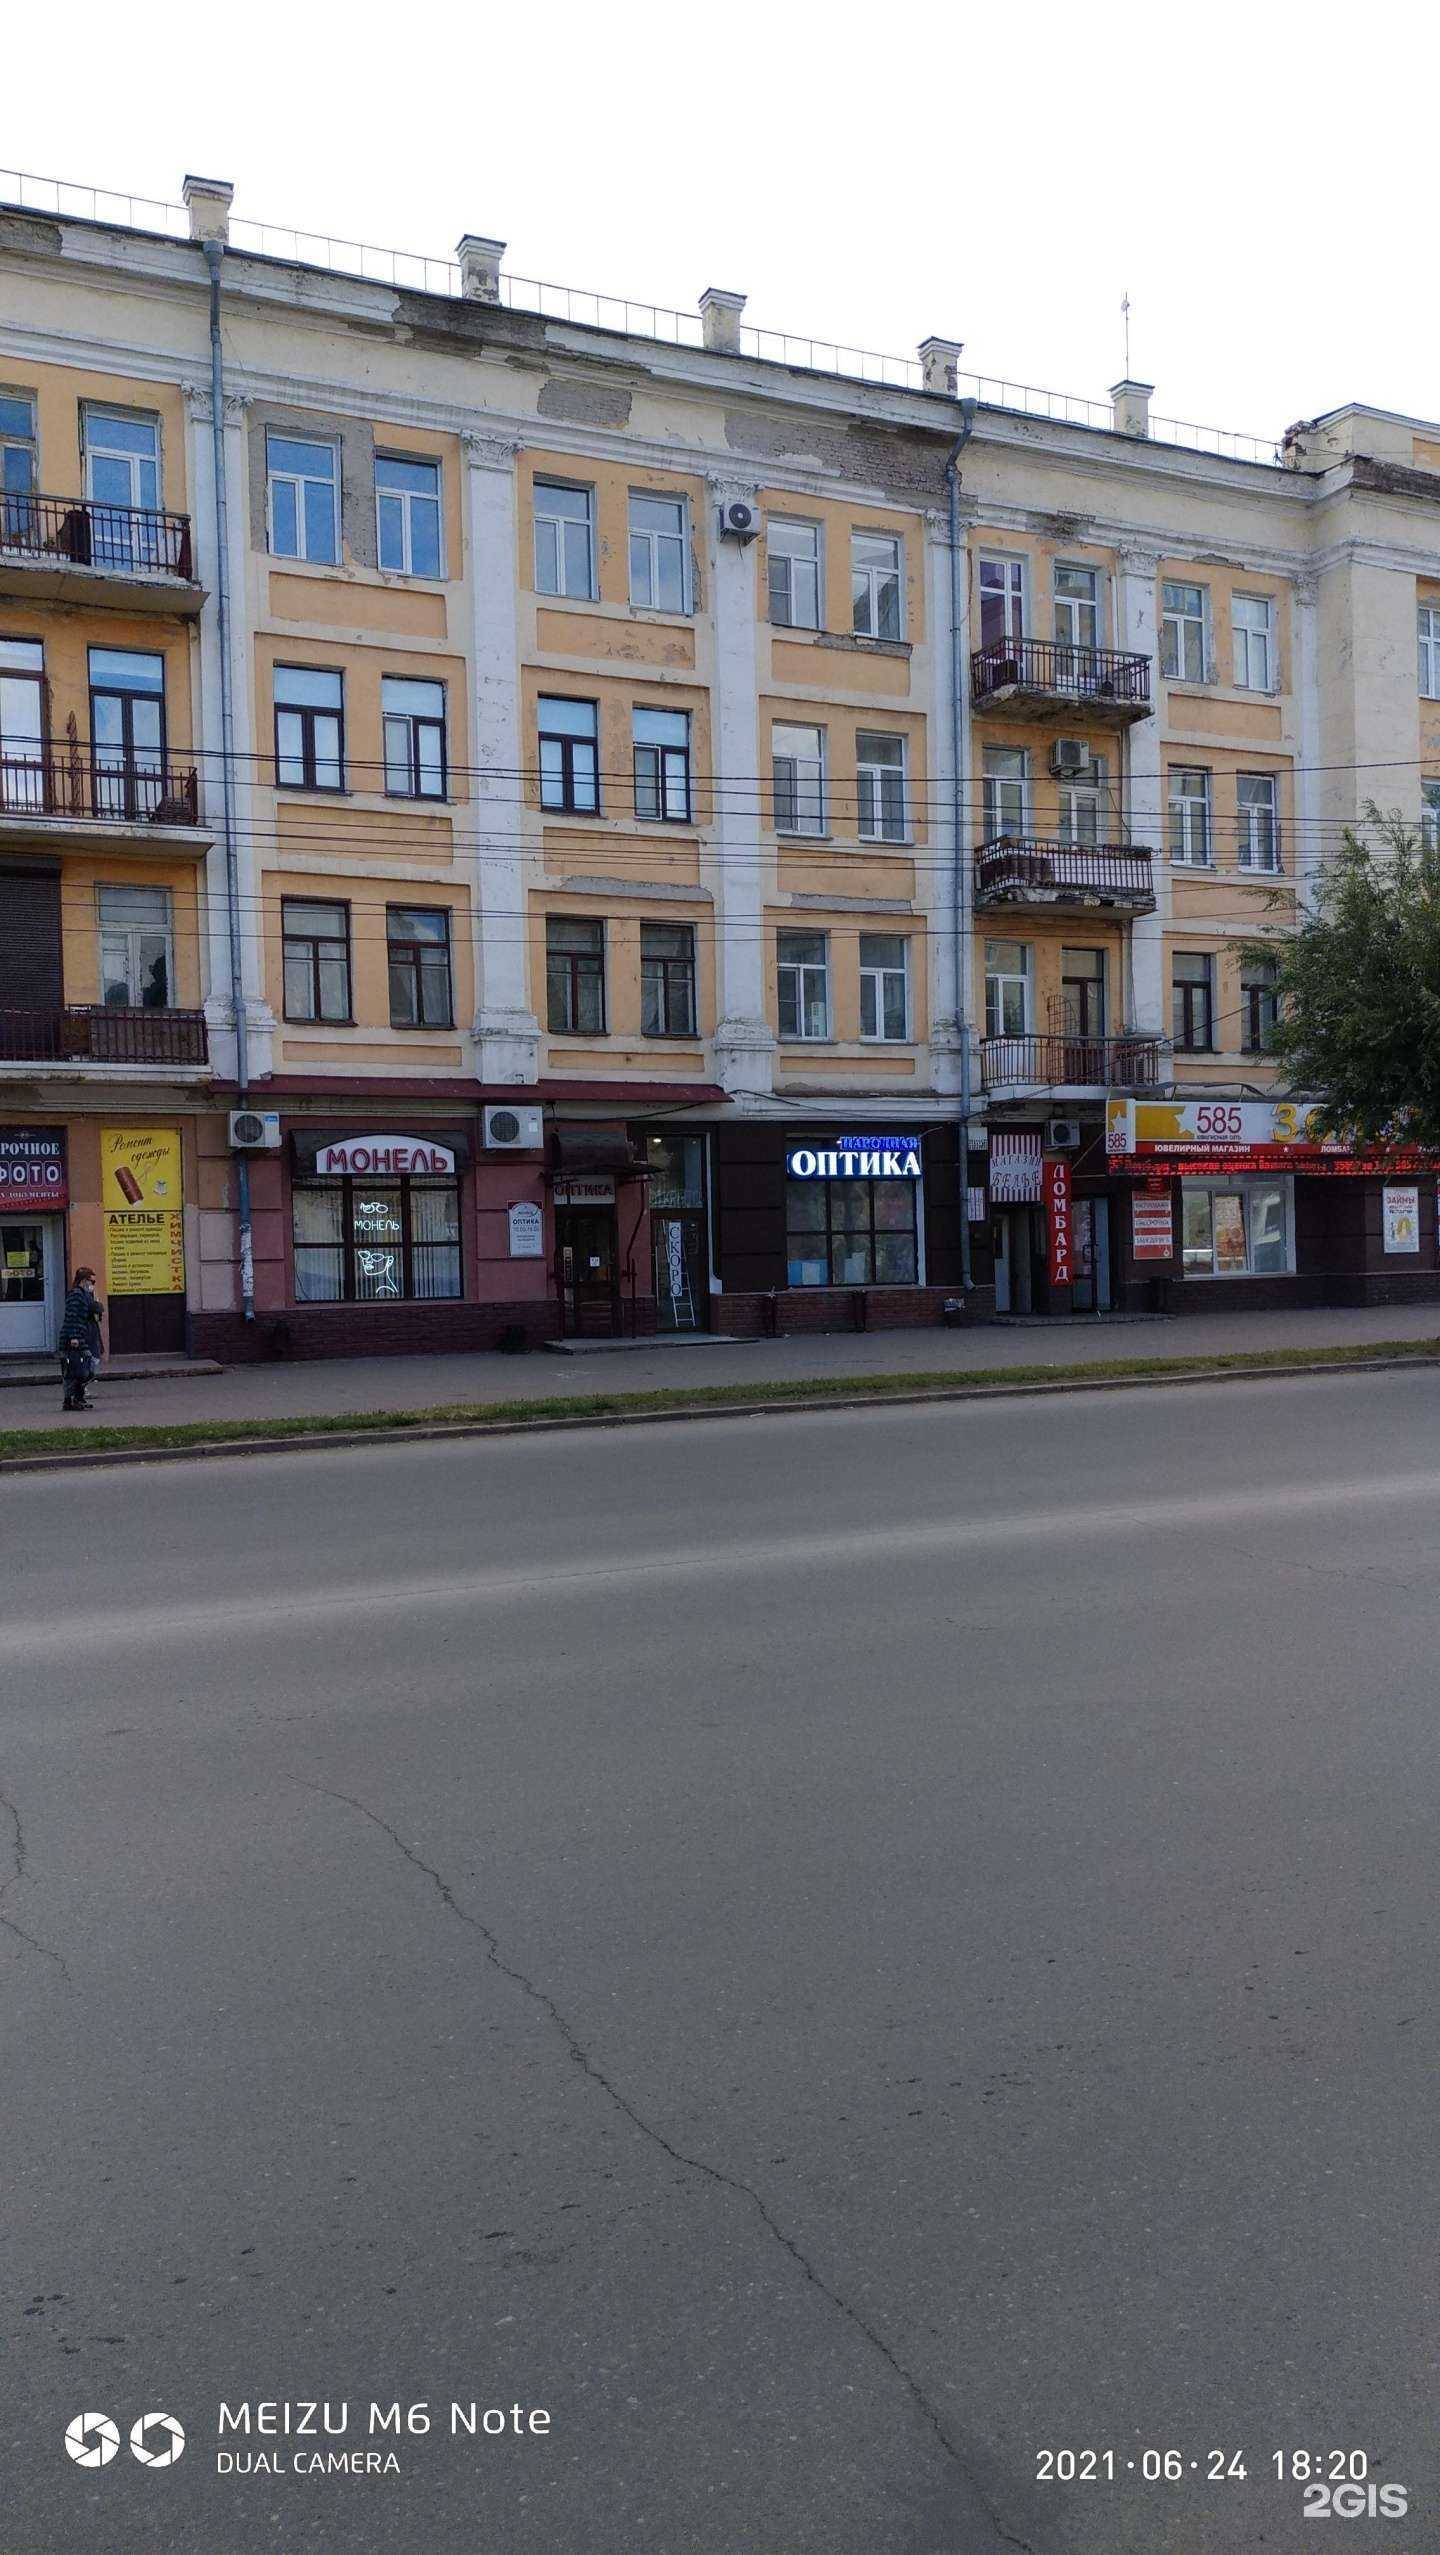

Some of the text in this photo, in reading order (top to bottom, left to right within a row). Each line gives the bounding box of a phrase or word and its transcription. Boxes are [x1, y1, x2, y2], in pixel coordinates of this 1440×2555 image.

[1197, 1107, 1242, 1134] 585
[1108, 1133, 1126, 1148] 585
[1154, 1143, 1251, 1153] ЮВЕЛИРНЫЙ МАГАЗИН
[326, 1148, 448, 1172] МОНЕЛЬ
[792, 1151, 921, 1176] ОПТИКА
[992, 1155, 1041, 1168] МАГАЗИН
[991, 1171, 1041, 1188] БЕЛЬЕ
[109, 1214, 165, 1224] АТЕЛЬЕ
[353, 1219, 400, 1231] МОНЕЛЬ
[1053, 1164, 1069, 1282] ЛОМБАРД
[170, 1212, 183, 1291] ХИМЧИСТКА
[669, 1225, 682, 1296] СКОРО
